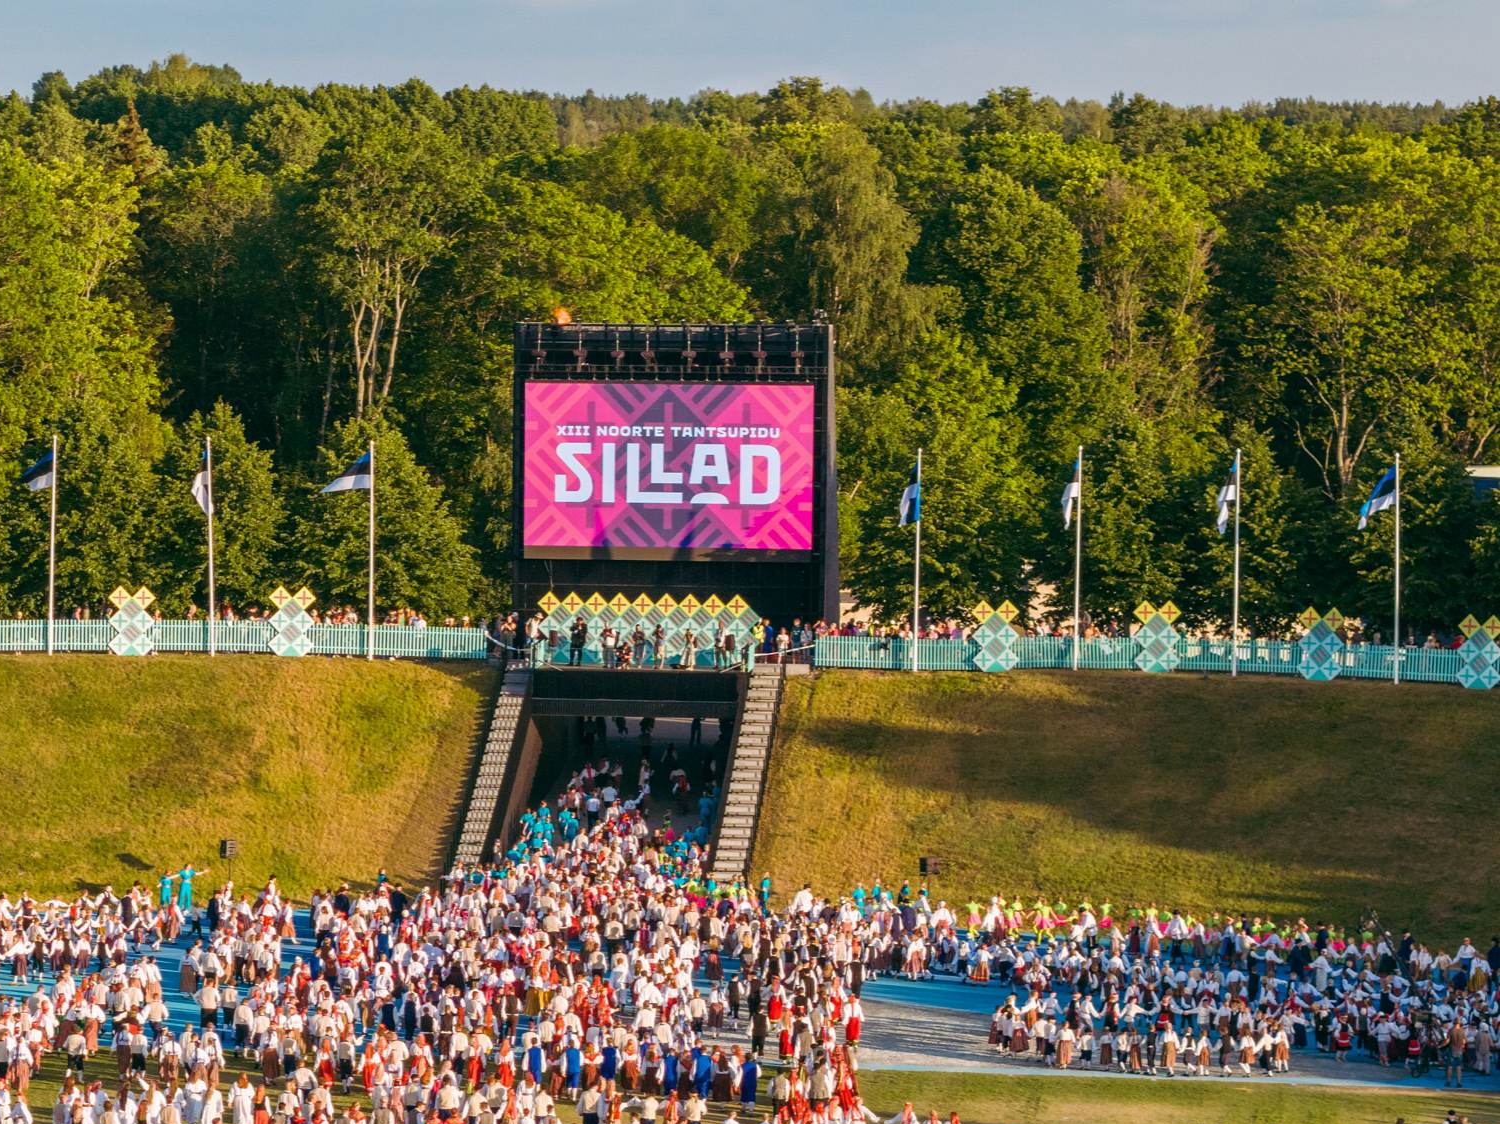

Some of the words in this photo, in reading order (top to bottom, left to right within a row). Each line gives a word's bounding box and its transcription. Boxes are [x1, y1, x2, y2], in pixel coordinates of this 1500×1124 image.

[556, 425, 590, 437] XIII
[596, 425, 664, 437] NOORTE
[671, 426, 781, 439] TANTSUPIDU
[554, 442, 781, 505] SILLAD
